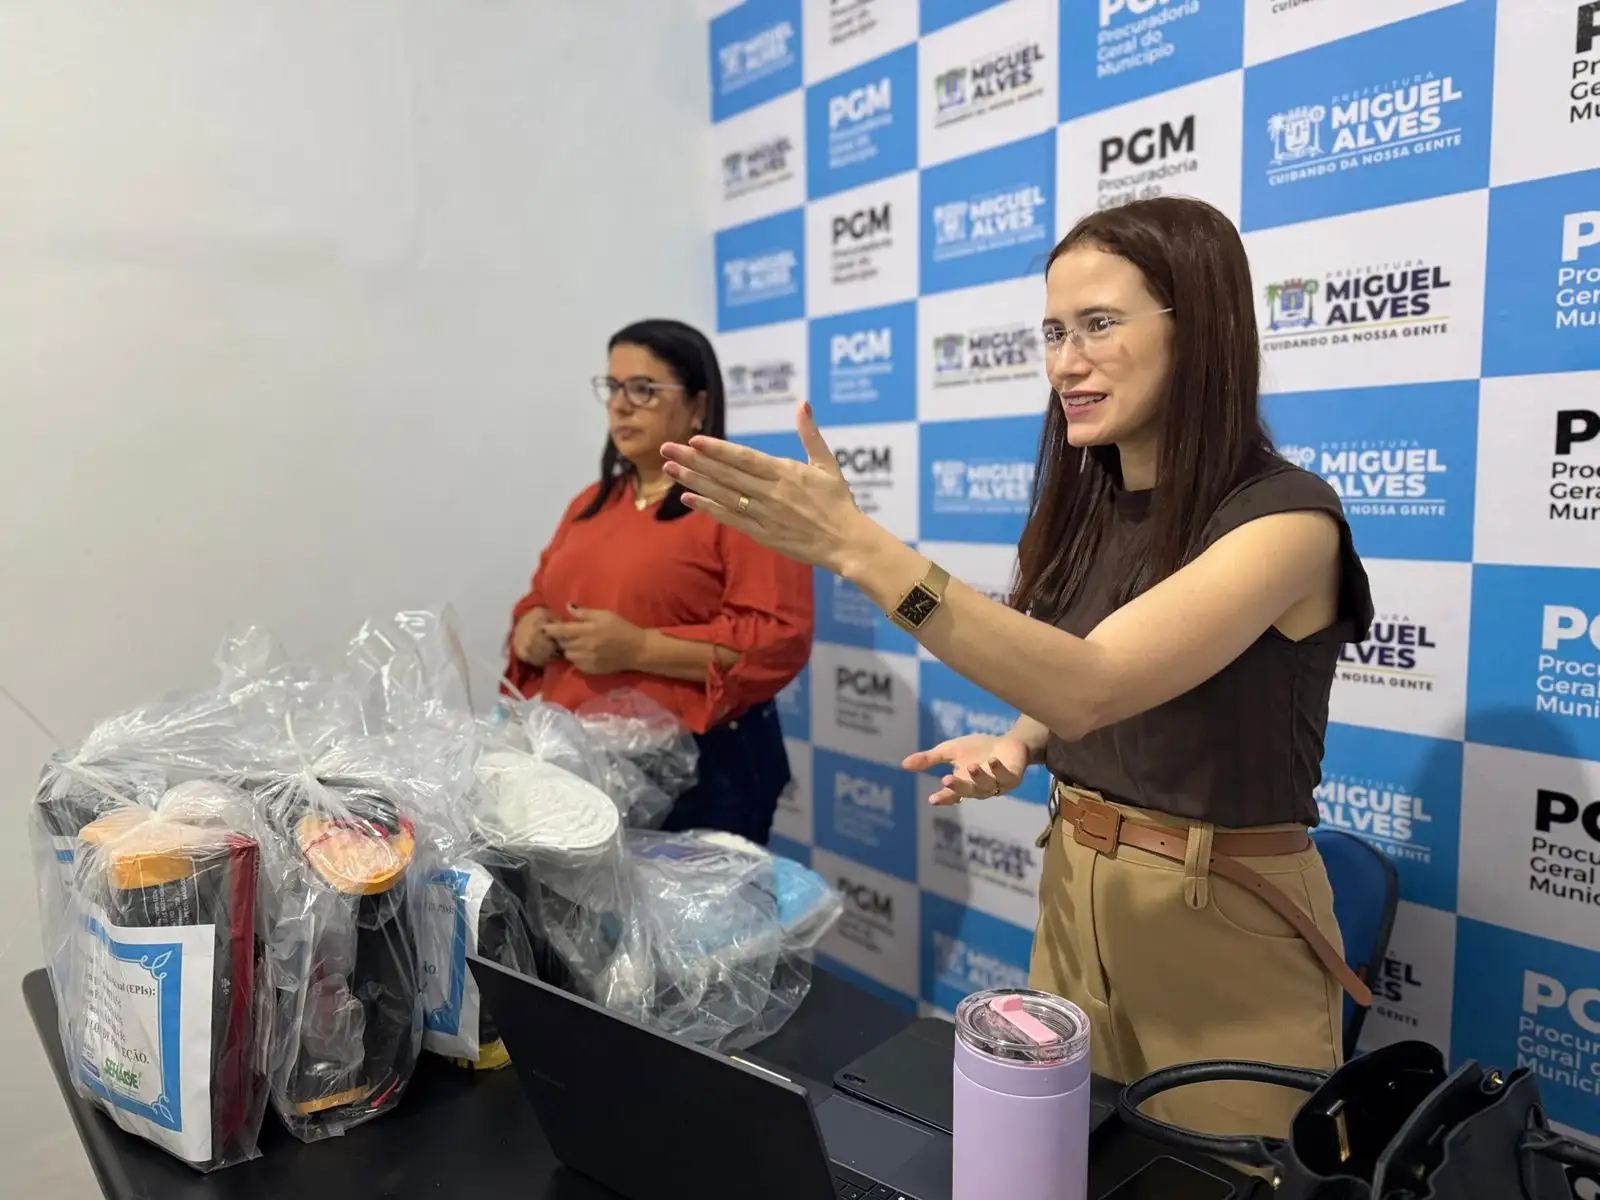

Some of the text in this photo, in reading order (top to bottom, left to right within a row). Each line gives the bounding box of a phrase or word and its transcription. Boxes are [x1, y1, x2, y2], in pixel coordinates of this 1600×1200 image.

[829, 77, 891, 130] PGM
[1331, 76, 1463, 129] MIGUEL
[1100, 114, 1195, 174] PGM
[1331, 105, 1441, 154] ALVES
[1268, 134, 1462, 187] CUIDANDO DA NOSSA GENTE
[832, 202, 892, 246] PGM
[1325, 266, 1451, 303] MIGUEL
[1326, 293, 1431, 326] ALVES
[831, 327, 892, 367] PGM
[1263, 323, 1448, 352] CUIDANDO DA NOSSA GENTE
[1320, 448, 1448, 474] MIGUEL
[1325, 473, 1427, 498] ALVES
[1350, 504, 1446, 516] NOSSA GENTE
[836, 664, 893, 702] PGM
[1341, 672, 1434, 691] NOSSA GENTE
[1312, 780, 1432, 823] MIGUEL
[1317, 801, 1413, 841] ALVES
[1530, 856, 1594, 885] Geral
[1517, 1036, 1581, 1070] Geral
